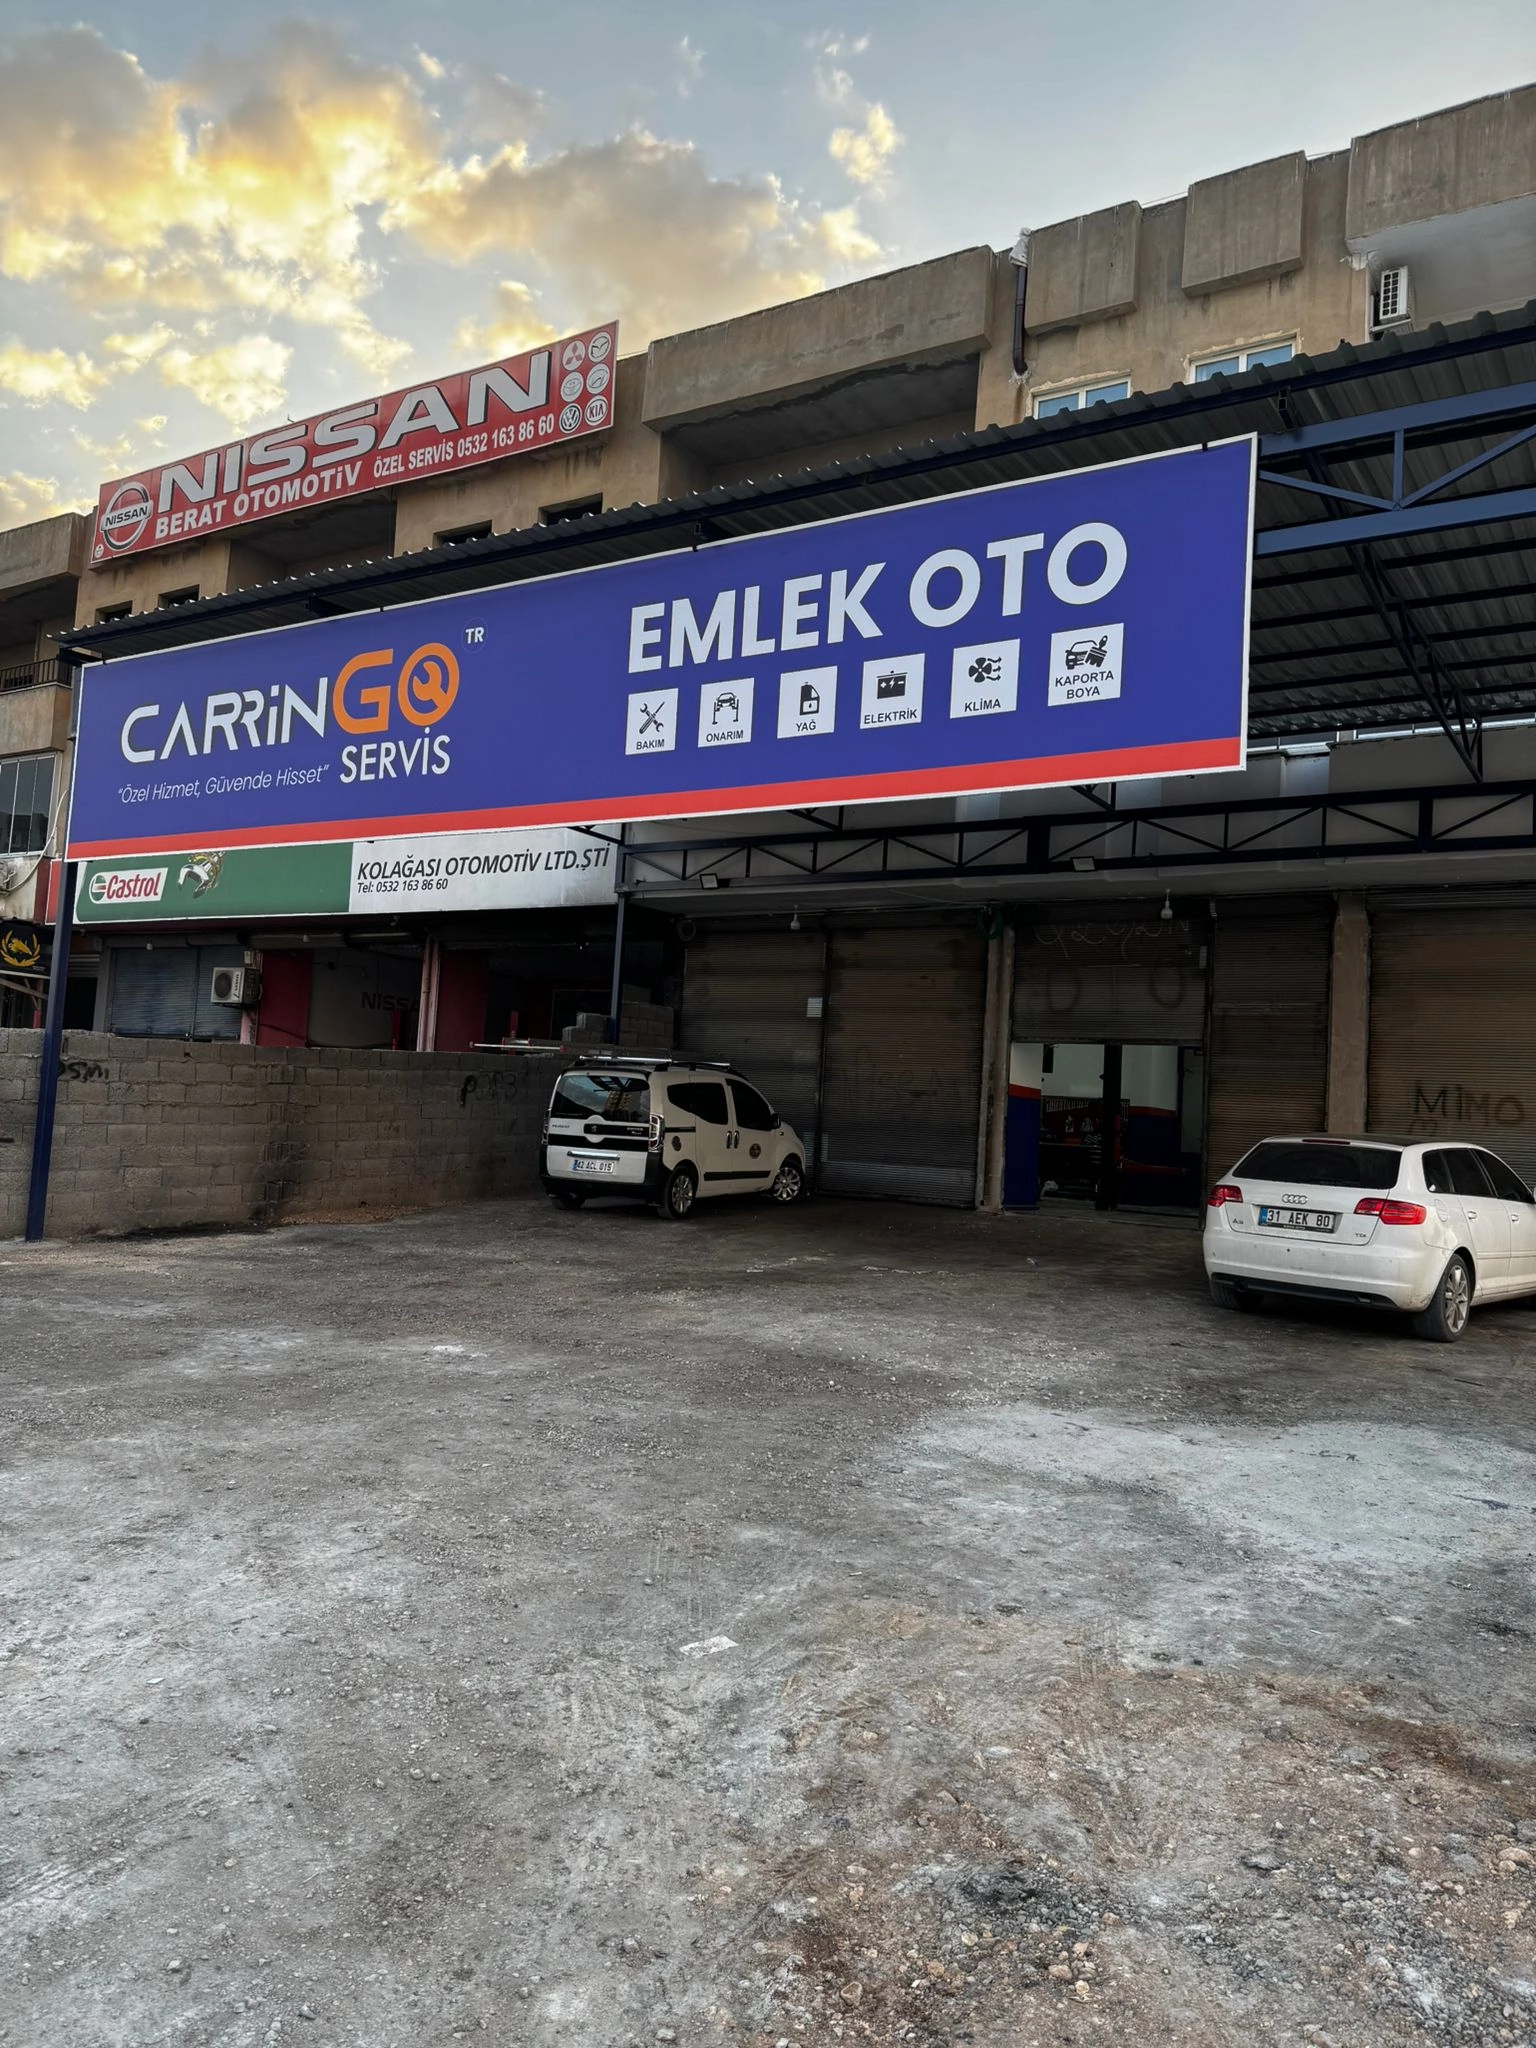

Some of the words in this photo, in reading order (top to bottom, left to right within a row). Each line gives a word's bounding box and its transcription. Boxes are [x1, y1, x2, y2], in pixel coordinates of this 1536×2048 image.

[589, 402, 605, 419] KIA
[157, 350, 552, 515] NISSAN
[155, 500, 227, 540] BERAT
[373, 455, 405, 478] ÖZEL
[408, 438, 454, 470] SERVİS
[457, 432, 488, 458] 0532
[492, 427, 514, 449] 163
[518, 421, 534, 442] 86
[538, 413, 554, 436] 60
[105, 505, 149, 528] NISSAN
[628, 562, 886, 674] EMLEK
[909, 521, 1128, 628] OTO
[465, 627, 485, 644] TR
[1055, 671, 1114, 687] KAPORTA
[1066, 686, 1101, 700] BOYA
[964, 697, 1001, 713] KLİMA
[796, 718, 817, 732] YAĞ
[863, 708, 918, 725] ELEKTRİK
[636, 738, 665, 751] BAKIM
[706, 729, 744, 743] ONARIM
[340, 726, 451, 784] SERVİS
[152, 779, 200, 800] Hizmet,
[205, 770, 272, 795] Güvende
[357, 854, 441, 881] KOLAĞASI
[445, 848, 542, 876] OTOMOTİV
[106, 871, 162, 900] Castrol
[357, 881, 374, 894] Tel:
[376, 880, 399, 893] 0532
[402, 879, 419, 891] 163
[421, 878, 434, 891] 86
[436, 878, 449, 890] 60
[361, 991, 420, 1013] NISSA
[1267, 1210, 1280, 1222] 31
[1288, 1212, 1309, 1225] AEK
[1316, 1215, 1330, 1228] 80
